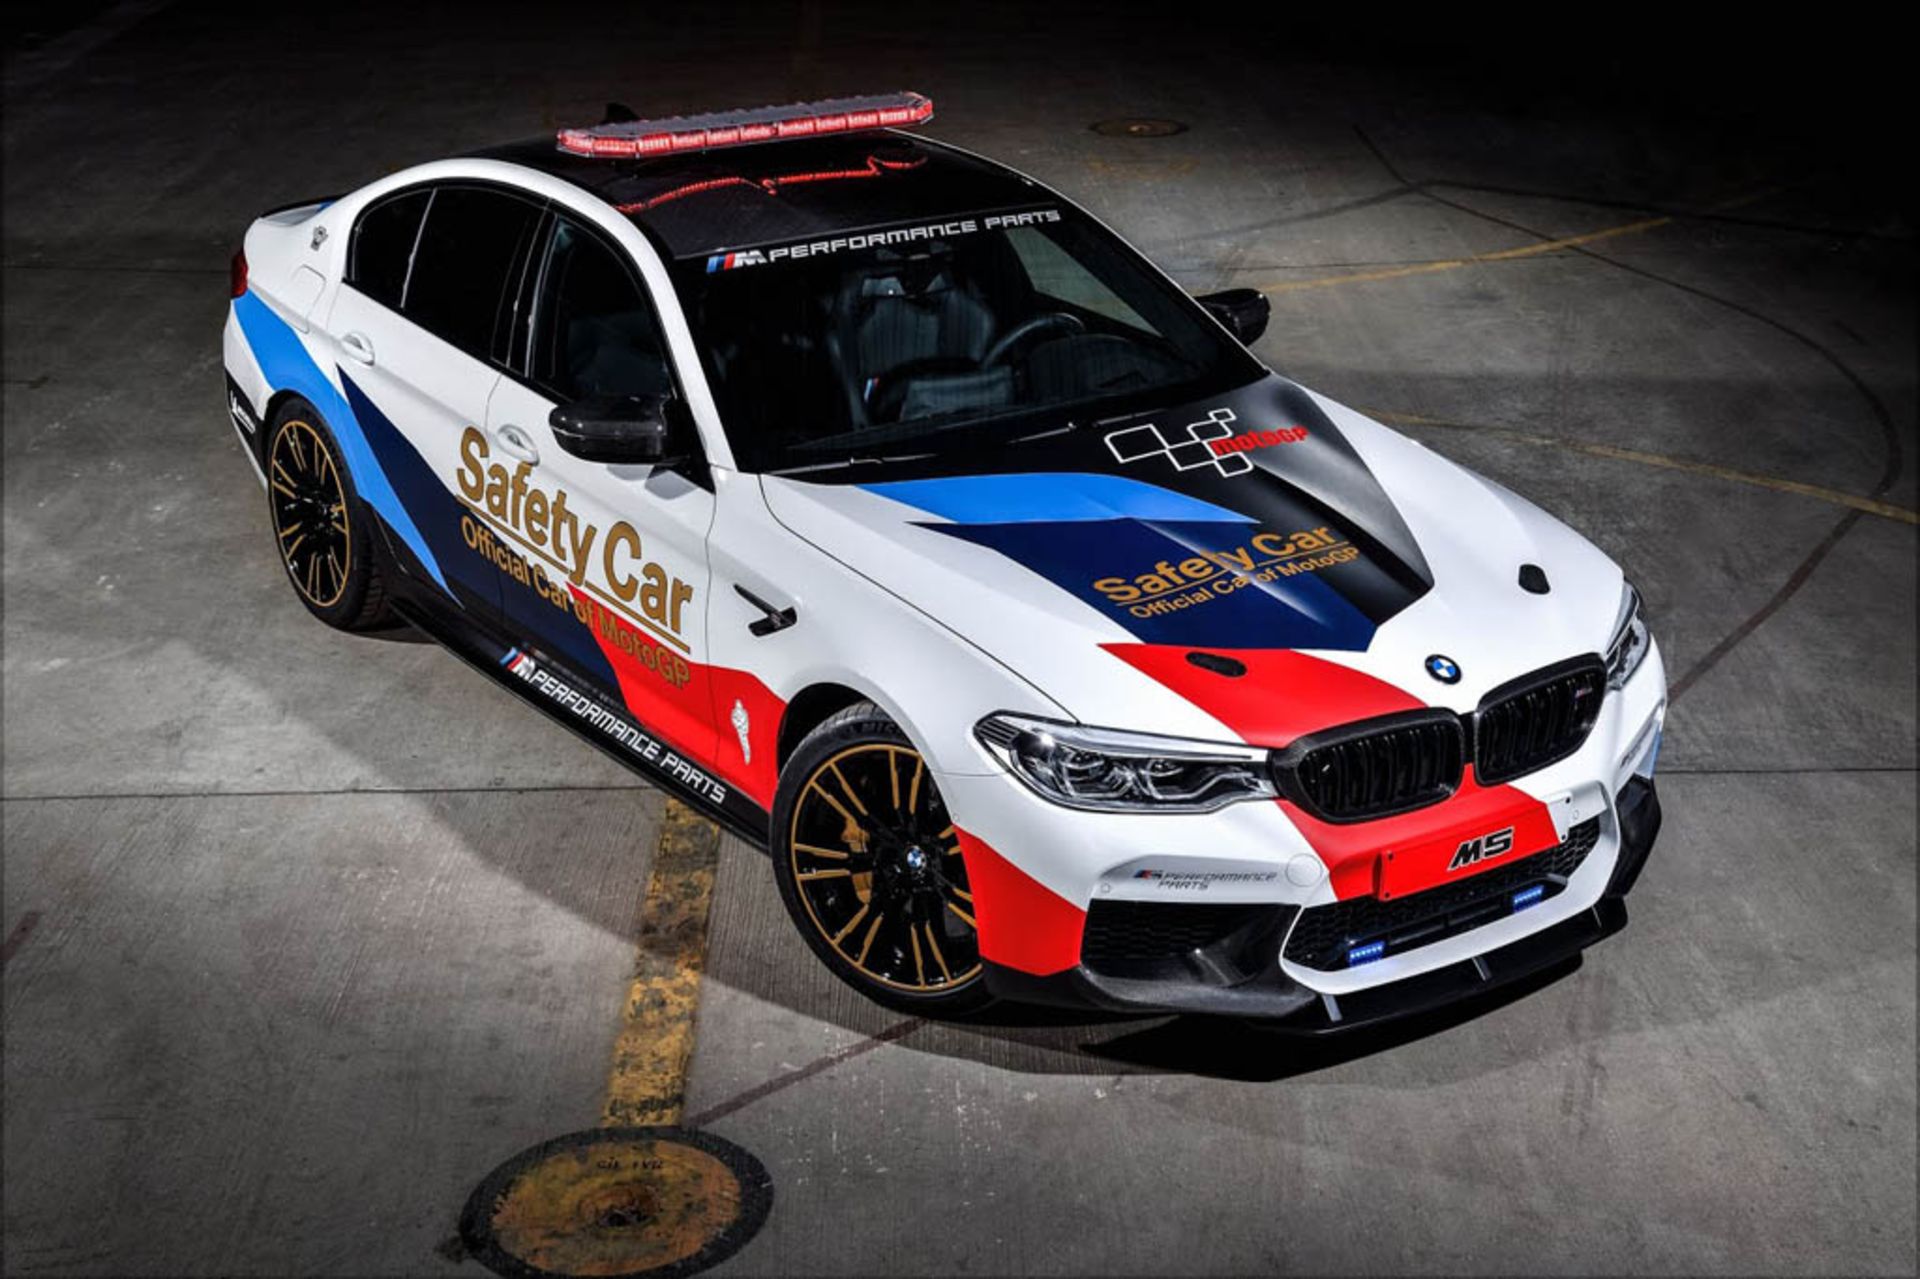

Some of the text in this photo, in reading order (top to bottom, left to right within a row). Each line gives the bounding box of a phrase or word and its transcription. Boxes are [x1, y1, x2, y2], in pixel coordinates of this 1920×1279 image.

[769, 220, 977, 263] PERFORMANCE
[985, 209, 1060, 230] PARTS
[457, 426, 694, 634] Safety Car
[1094, 526, 1337, 601] Safety Car
[462, 516, 691, 690] Official Car of MotoGP
[1128, 546, 1359, 618] Official Car of MotoGP
[530, 669, 660, 760] PERFORMANCE
[659, 755, 726, 803] PARTS
[1158, 880, 1209, 890] PARTS
[1164, 871, 1277, 882] PERFORMANCE
